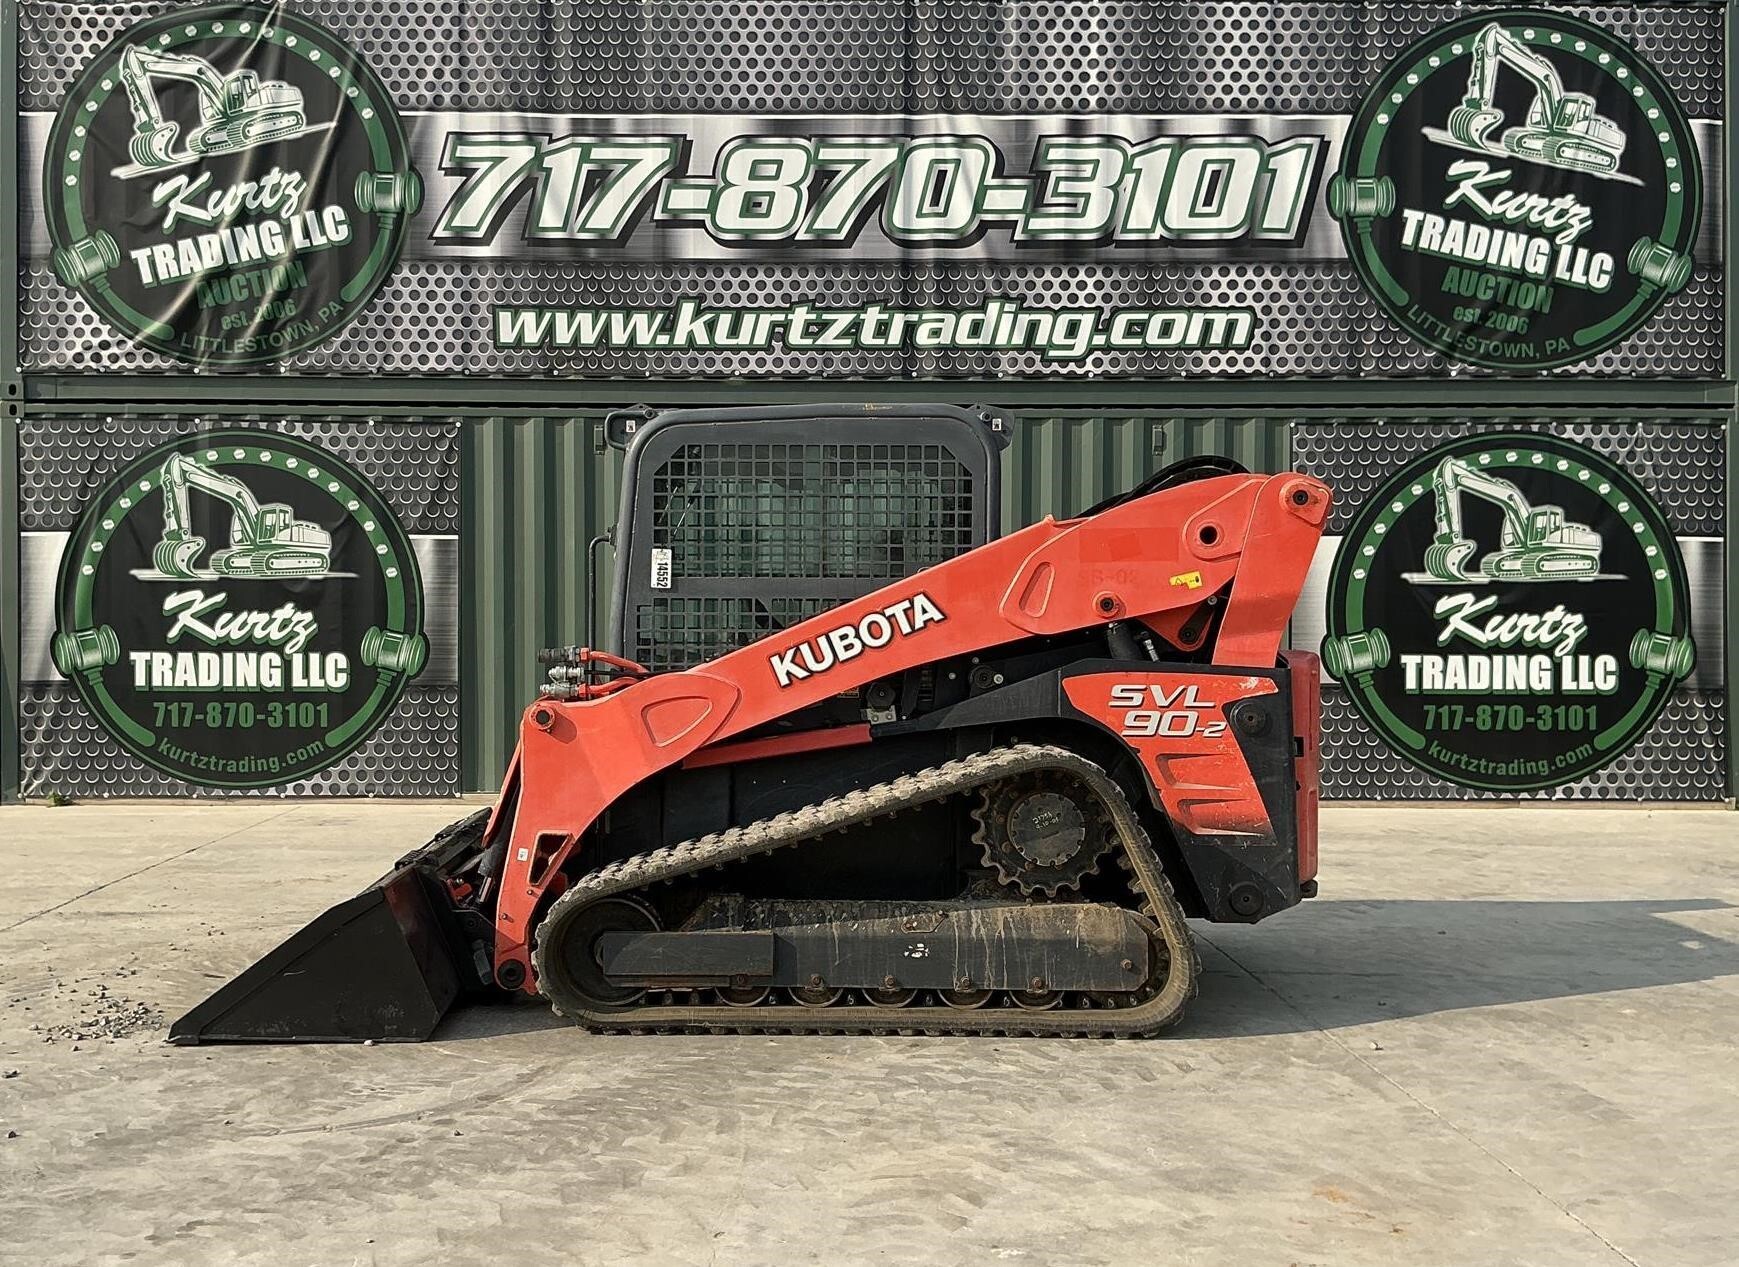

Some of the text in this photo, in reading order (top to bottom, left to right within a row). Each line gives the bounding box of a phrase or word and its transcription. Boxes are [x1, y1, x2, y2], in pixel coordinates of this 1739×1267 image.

[151, 166, 307, 232] Kurtz
[432, 134, 1323, 241] 717-870-3101
[1444, 159, 1593, 245] Kurtz
[130, 204, 352, 286] TRADING LLC
[1401, 208, 1615, 291] TRADING LLC
[195, 261, 308, 309] AUCTION
[1441, 265, 1554, 314] AUCTION
[180, 300, 344, 353] LITTLESTOWN, PA
[220, 311, 252, 331] est.
[495, 297, 1256, 361] www.kurtztrading.com
[1407, 303, 1571, 360] LITTLESTOWN, PA
[1484, 310, 1530, 336] 2006
[656, 561, 669, 588] 14552
[162, 589, 318, 657] Kurtz
[769, 592, 946, 687] KUBOTA
[1434, 592, 1588, 658] Kurtz
[129, 652, 350, 689] TRADING LLC
[1400, 655, 1618, 691] TRADING LLC
[153, 702, 329, 729] 717-870-3101
[1107, 684, 1217, 709] SVL
[1423, 704, 1598, 732] 717-870-3101
[1120, 710, 1228, 739] 90-2
[157, 737, 325, 773] kurtztrading.com
[1427, 740, 1594, 776] kurtztrading.com
